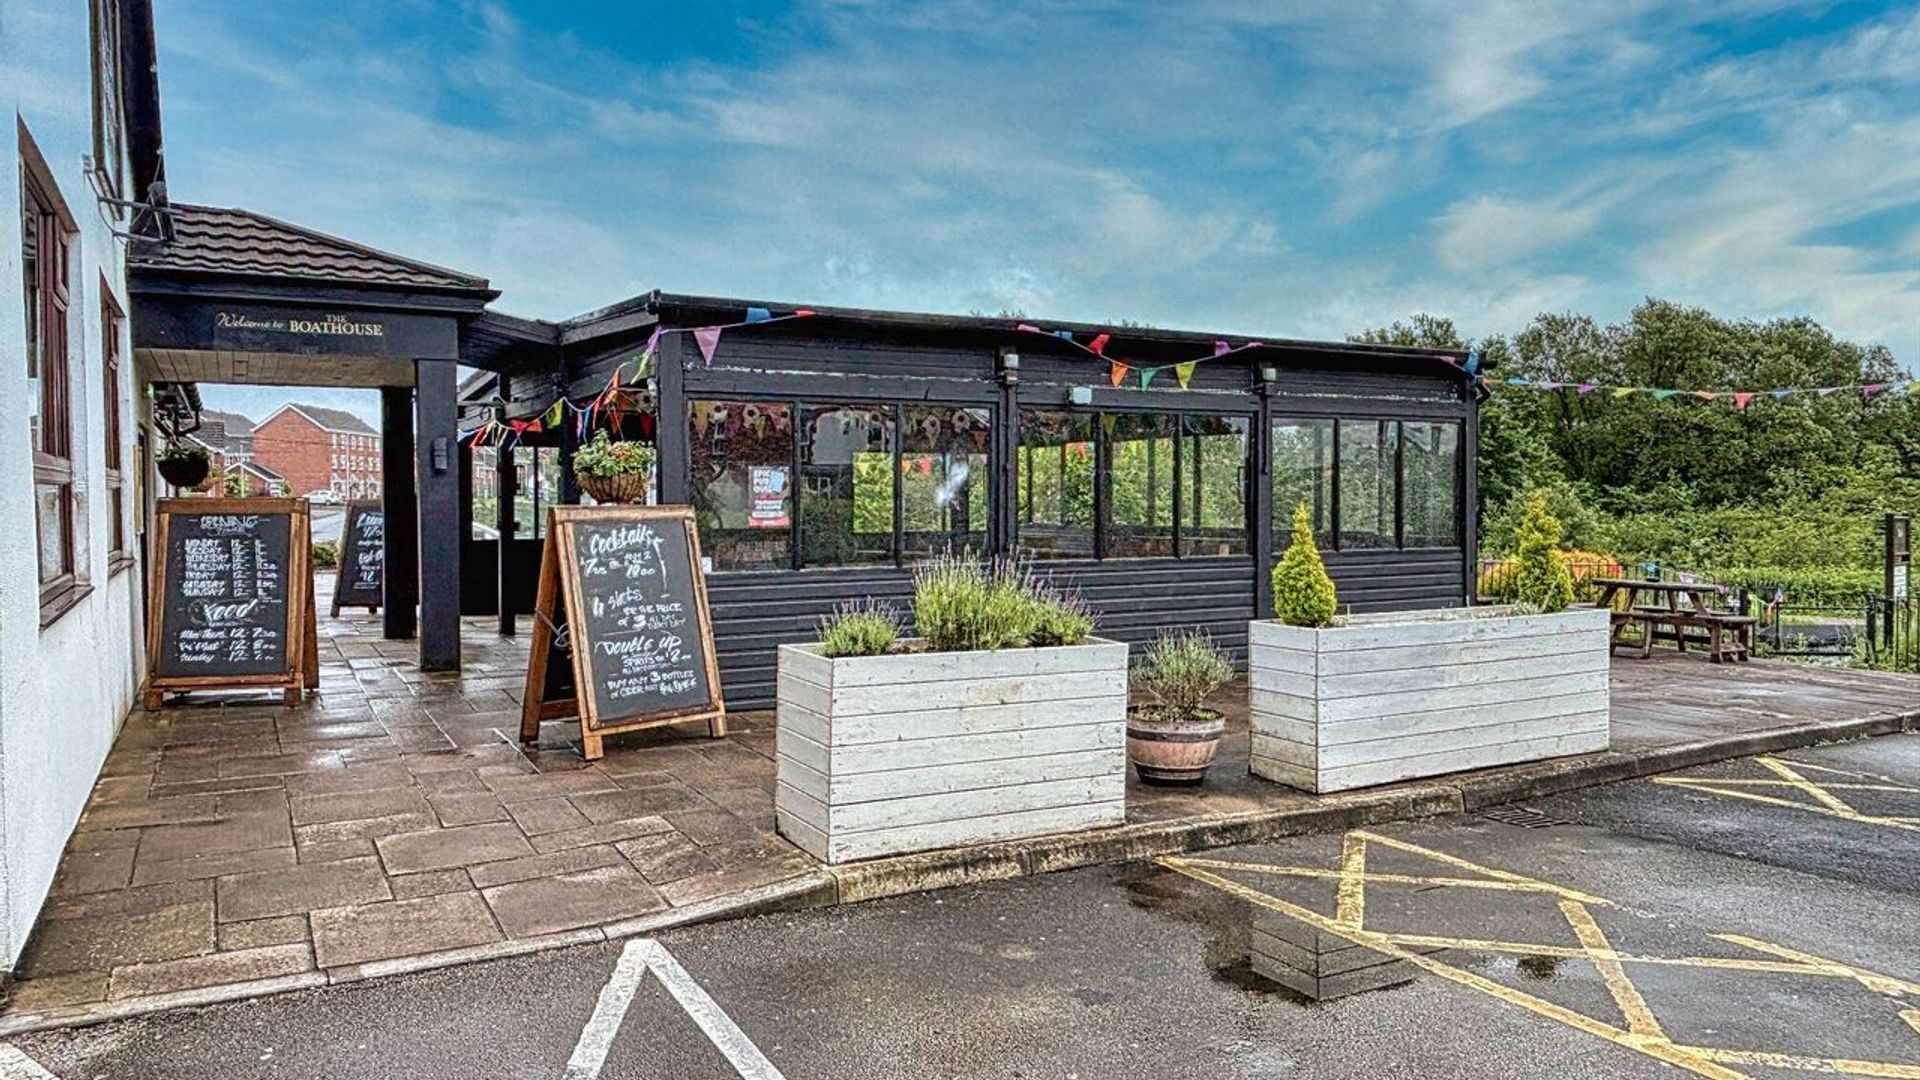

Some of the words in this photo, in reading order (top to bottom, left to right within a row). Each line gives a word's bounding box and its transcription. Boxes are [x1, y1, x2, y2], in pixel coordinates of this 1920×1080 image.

[215, 312, 270, 329] Welcome
[272, 319, 285, 329] to
[326, 314, 347, 323] THE
[289, 320, 384, 336] BOATHOUSE
[590, 523, 654, 557] Cocktails
[632, 614, 647, 630] 3
[650, 671, 661, 683] 3
